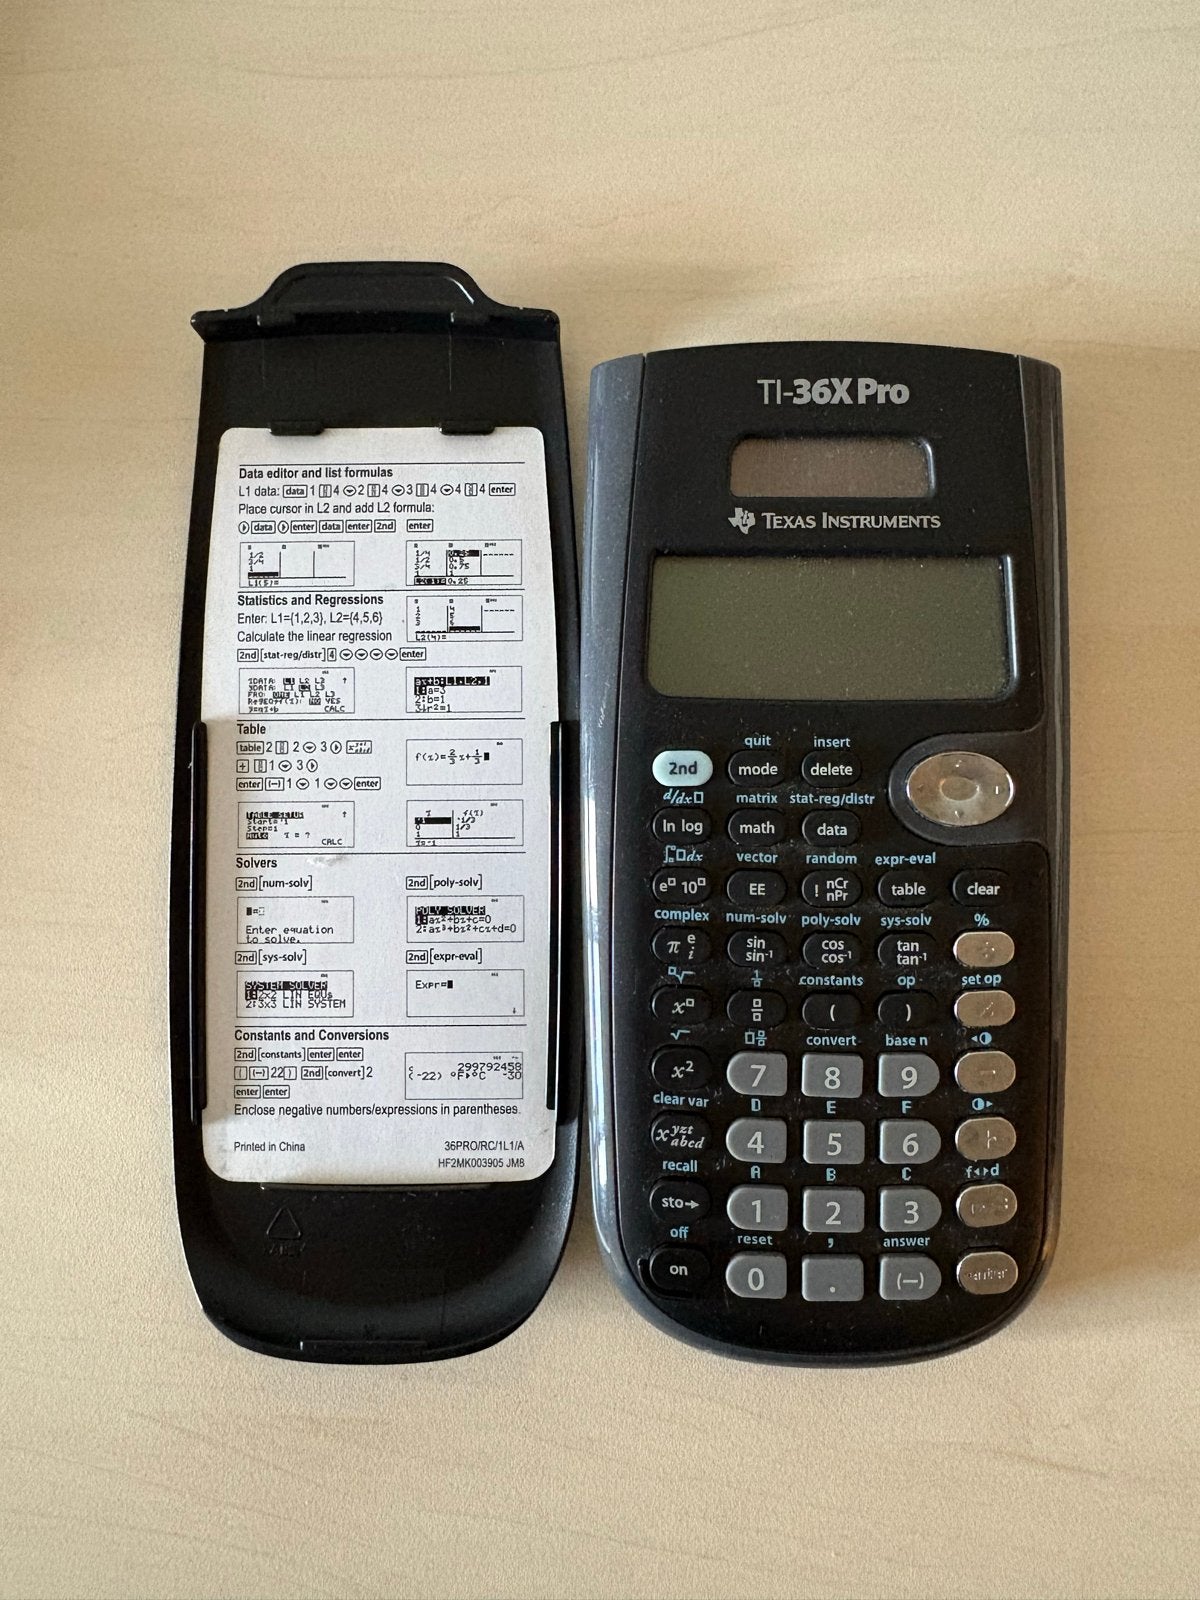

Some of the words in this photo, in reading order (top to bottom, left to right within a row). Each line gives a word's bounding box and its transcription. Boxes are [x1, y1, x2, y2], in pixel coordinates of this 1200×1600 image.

[757, 377, 853, 404] TI-36X
[858, 378, 910, 405] Pro
[239, 468, 263, 478] Data
[267, 468, 298, 478] editor
[302, 467, 322, 478] and
[325, 467, 341, 478] list
[345, 467, 393, 477] formulas
[239, 486, 250, 496] L1
[255, 485, 280, 496] data:
[286, 487, 305, 495] data
[491, 485, 513, 493] enter
[239, 504, 266, 514] Place
[270, 504, 301, 513] cursor
[305, 503, 313, 513] in
[317, 502, 329, 513] L2
[333, 502, 351, 513] and
[355, 502, 374, 513] add
[377, 502, 390, 512] L2
[393, 502, 434, 513] formula:
[254, 522, 273, 531] data
[293, 523, 314, 531] enter
[322, 522, 341, 531] data
[348, 522, 370, 531] enter
[376, 522, 394, 530] 2nd
[409, 521, 431, 530] enter
[761, 511, 816, 529] TEXAS
[822, 511, 941, 529] INSTRUMENTS
[237, 595, 288, 606] Statistics
[291, 594, 311, 605] and
[315, 594, 384, 607] Regressions
[237, 631, 284, 642] Calculate
[288, 631, 304, 641] the
[307, 631, 335, 641] linear
[339, 630, 392, 643] regression
[239, 651, 256, 659] 2nd
[402, 649, 424, 658] enter
[237, 723, 266, 734] Table
[744, 735, 771, 746] quit
[813, 736, 851, 747] insert
[239, 744, 261, 752] table
[669, 761, 697, 775] 2nd
[738, 762, 778, 775] mode
[810, 763, 853, 776] delete
[736, 792, 778, 804] matrix
[789, 793, 875, 806] stat-reg/distr
[663, 820, 676, 832] ln
[681, 820, 703, 834] log
[739, 821, 775, 834] math
[817, 823, 847, 836] data
[236, 857, 277, 868] Solvers
[736, 852, 778, 863] vector
[806, 852, 857, 864] random
[875, 852, 937, 867] expr-eval
[238, 880, 255, 888] 2nd
[408, 879, 425, 887] 2nd
[749, 883, 765, 895] EE
[826, 878, 848, 889] nCr
[891, 882, 926, 895] table
[967, 882, 1000, 895] clear
[826, 890, 848, 901] nPr
[654, 909, 709, 922] complex
[726, 912, 787, 924] num-solv
[801, 913, 861, 927] poly-solv
[880, 914, 932, 927] sys-solv
[974, 913, 990, 927] %
[246, 925, 277, 934] Enter
[746, 936, 765, 948] sin
[822, 940, 845, 950] cos
[897, 941, 919, 952] tan
[237, 954, 255, 962] 2nd
[408, 953, 425, 961] 2nd
[800, 975, 864, 986] constants
[897, 975, 915, 988] op
[962, 975, 981, 985] set
[984, 974, 1002, 987] op
[234, 1030, 291, 1041] Constants
[295, 1030, 315, 1041] and
[319, 1029, 389, 1040] Conversions
[806, 1035, 857, 1046] convert
[885, 1034, 917, 1046] base
[919, 1036, 928, 1046] n
[237, 1050, 254, 1058] 2nd
[304, 1069, 321, 1077] 2nd
[458, 1062, 522, 1071] 299792458
[750, 1065, 767, 1087] 7
[824, 1067, 841, 1089] 8
[901, 1067, 917, 1089] 9
[236, 1088, 258, 1096] enter
[265, 1088, 287, 1096] enter
[653, 1092, 685, 1106] clear
[688, 1097, 709, 1107] var
[751, 1099, 760, 1112] D
[234, 1104, 275, 1115] Enclose
[279, 1104, 322, 1118] negative
[326, 1103, 438, 1117] numbers/expressions
[441, 1103, 450, 1115] in
[453, 1103, 521, 1117] parentheses.
[827, 1101, 836, 1114] E
[902, 1100, 912, 1114] F
[234, 1142, 265, 1151] Printed
[269, 1142, 276, 1151] in
[279, 1142, 305, 1151] China
[747, 1131, 764, 1154] 4
[827, 1133, 842, 1156] 5
[903, 1133, 919, 1157] 6
[662, 1160, 698, 1173] recall
[750, 1166, 760, 1179] A
[826, 1168, 836, 1181] B
[902, 1167, 912, 1181] C
[662, 1197, 683, 1209] sto
[751, 1200, 761, 1223] 1
[825, 1201, 841, 1225] 2
[904, 1201, 919, 1224] 3
[670, 1226, 689, 1239] off
[737, 1235, 773, 1246] reset
[883, 1236, 930, 1247] answer
[669, 1265, 688, 1276] on
[747, 1268, 764, 1291] 0
